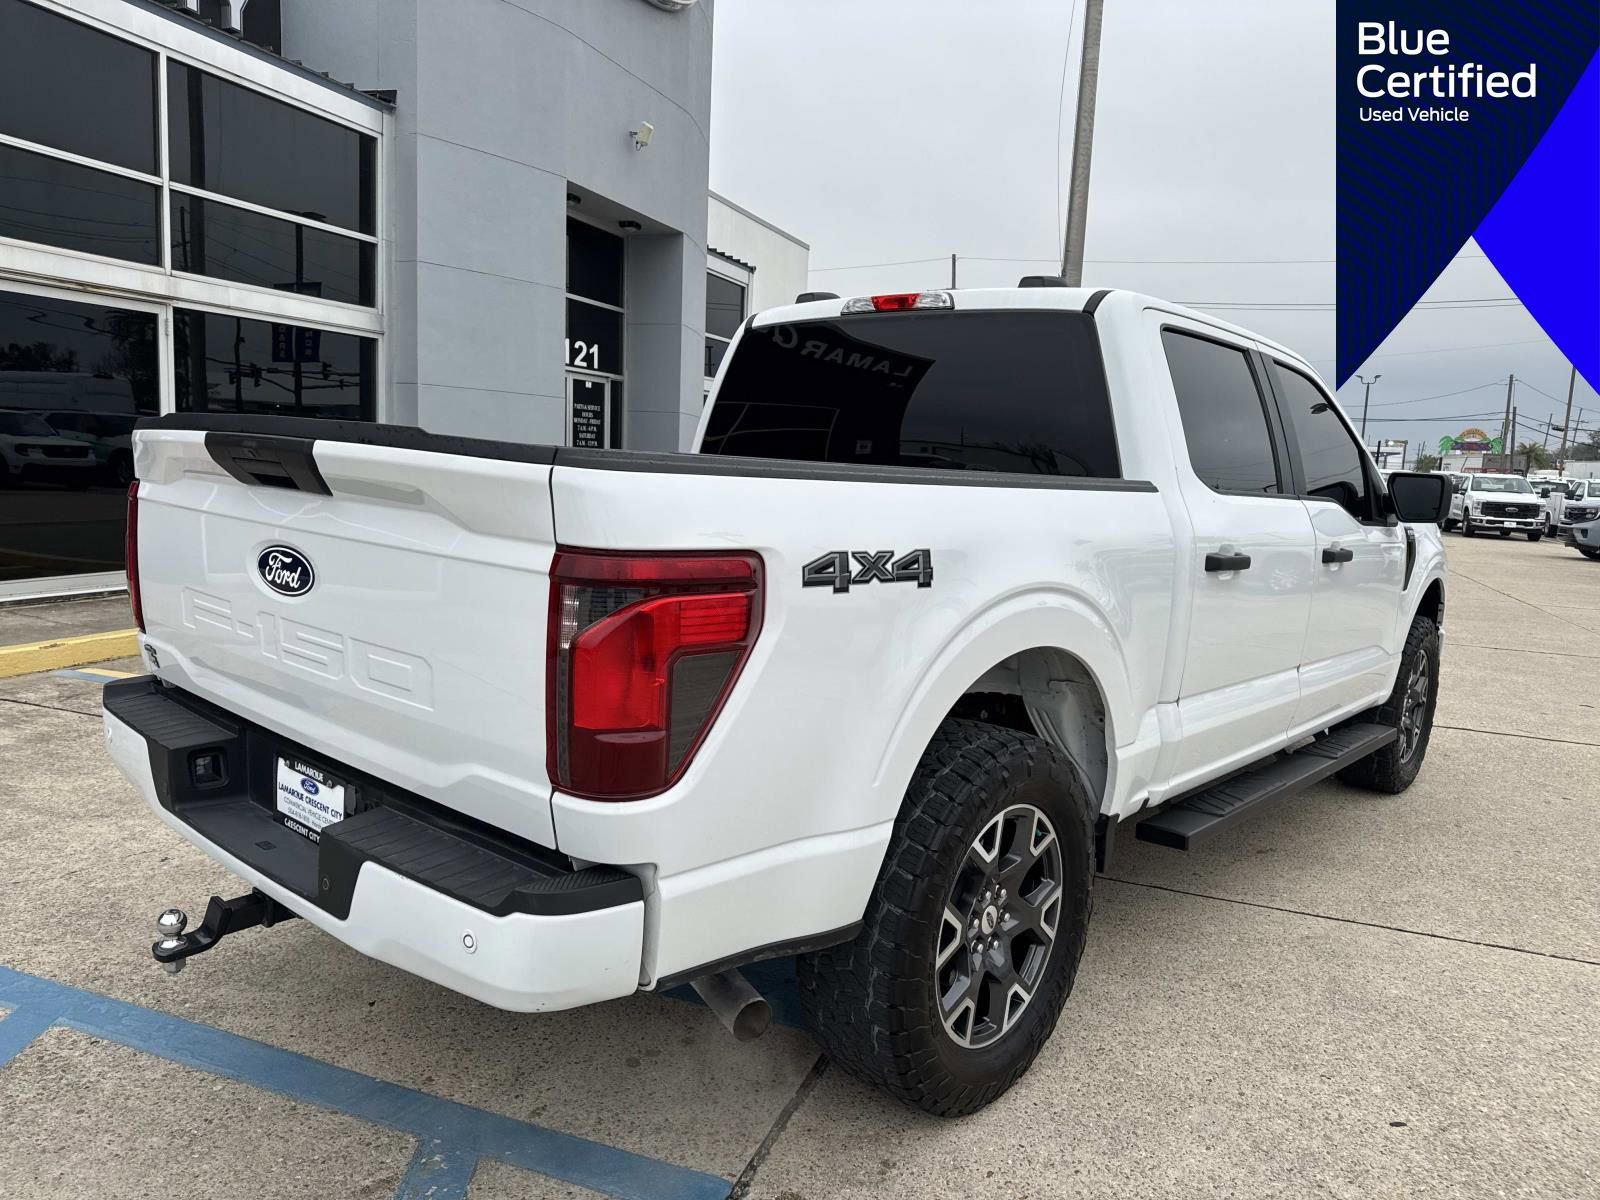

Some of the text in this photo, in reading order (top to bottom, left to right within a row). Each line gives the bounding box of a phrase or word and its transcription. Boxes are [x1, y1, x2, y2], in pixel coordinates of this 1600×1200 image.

[262, 549, 305, 591] Ford
[182, 586, 435, 712] F-150
[294, 760, 324, 782] LAMARQUE
[302, 778, 318, 795] Ford
[278, 781, 305, 801] LAMARQUE
[305, 795, 330, 814] CRESCENT
[330, 808, 343, 821] CITY
[284, 817, 309, 838] CRESCENT
[308, 831, 321, 843] CITY
